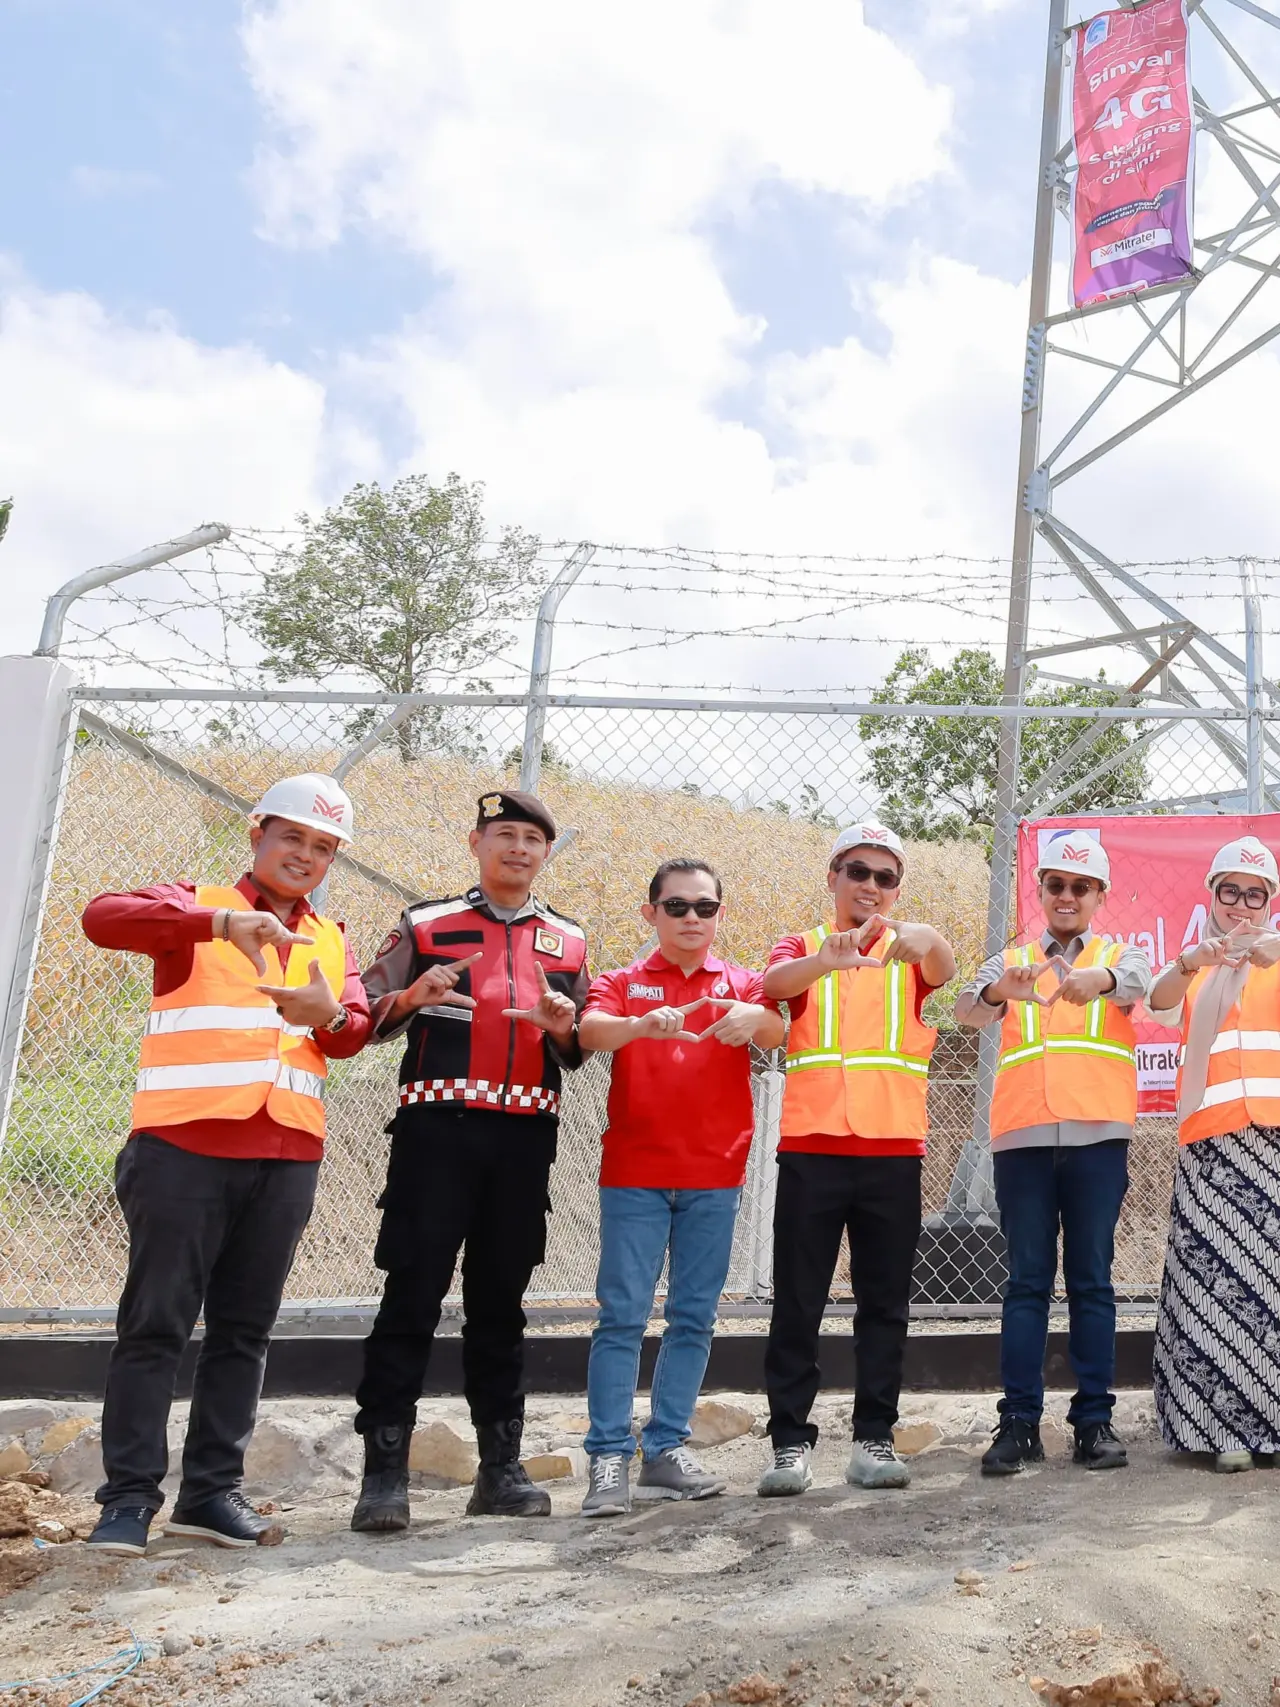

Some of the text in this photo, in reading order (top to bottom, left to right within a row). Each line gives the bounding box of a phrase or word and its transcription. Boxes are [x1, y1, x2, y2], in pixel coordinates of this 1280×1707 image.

[1089, 49, 1172, 93] Sinyal
[1092, 85, 1172, 130] 4G
[1089, 121, 1182, 165] Sekarang
[1109, 140, 1157, 170] hadir
[1114, 230, 1156, 253] Mitratel
[629, 983, 663, 998] SIMPATI
[1137, 1048, 1180, 1072] itrate
